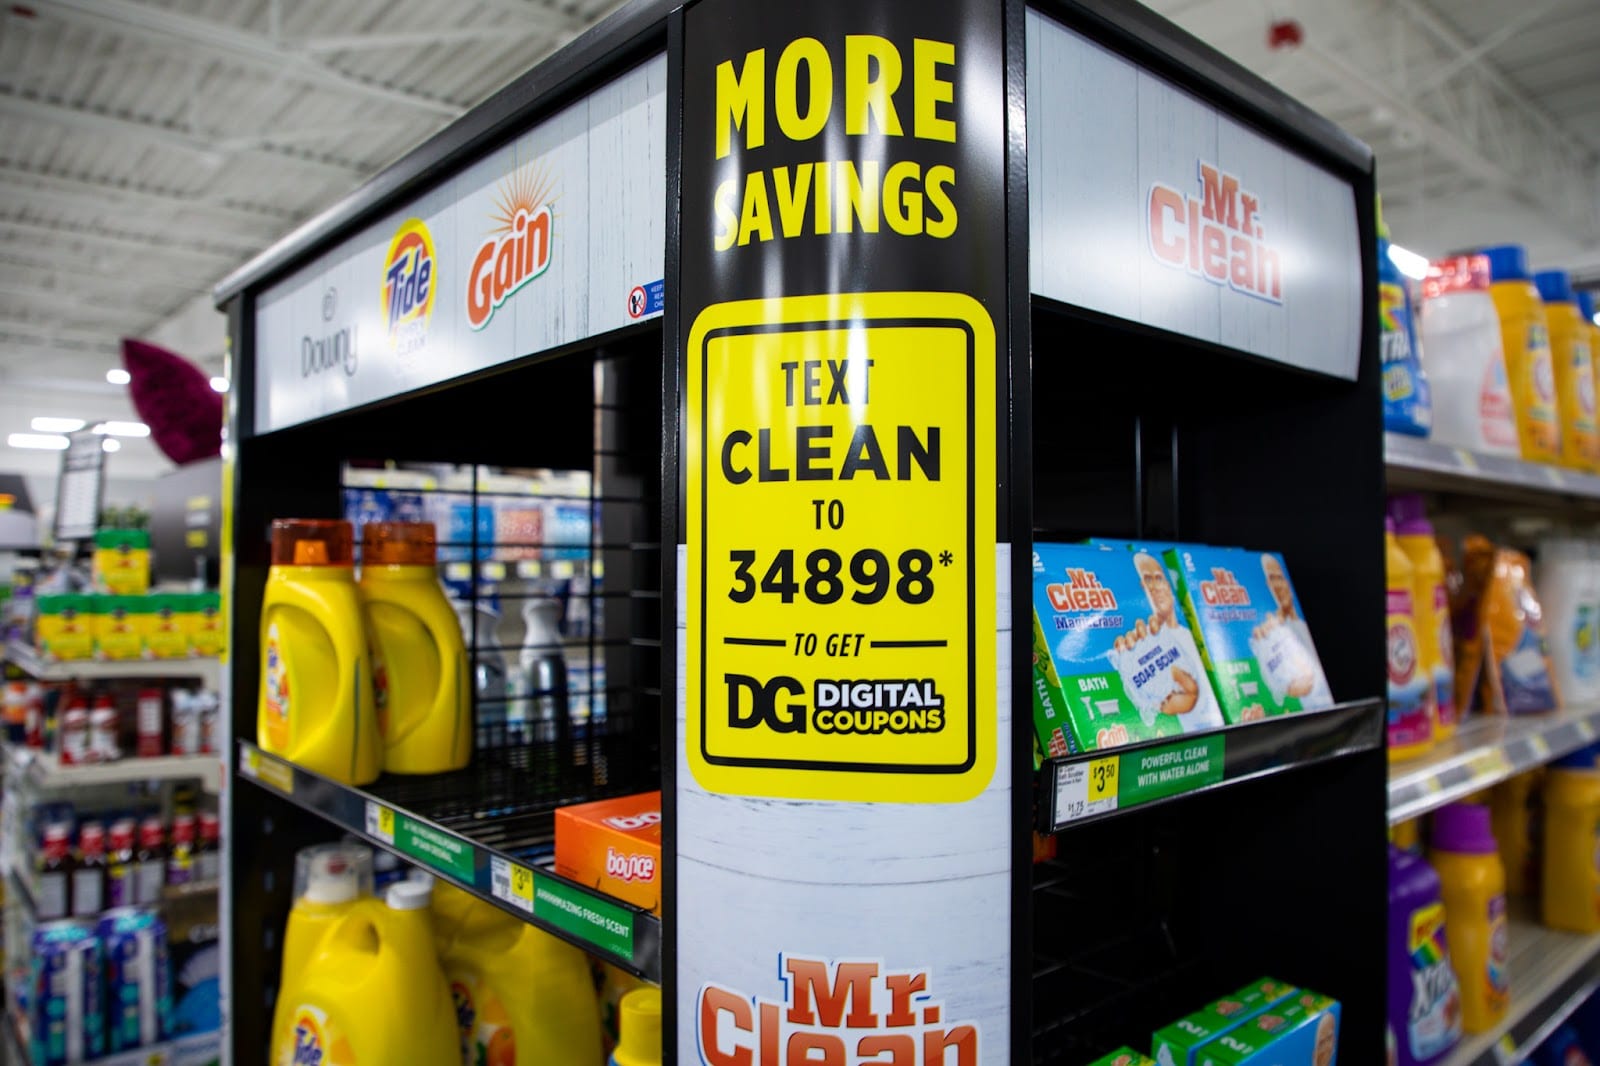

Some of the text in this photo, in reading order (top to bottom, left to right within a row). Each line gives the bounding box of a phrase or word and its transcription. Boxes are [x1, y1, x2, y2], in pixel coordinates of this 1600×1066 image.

[715, 34, 957, 161] MORE
[713, 159, 958, 252] SAVINGS
[1200, 163, 1263, 240] Mr.
[1149, 184, 1282, 300] Clean
[466, 211, 549, 326] Gain
[386, 248, 432, 336] Tide
[301, 323, 359, 377] Downy
[780, 358, 875, 407] TEXT
[720, 424, 941, 485] CLEAN
[812, 499, 845, 530] TO
[1047, 584, 1117, 611] Clean
[1066, 568, 1101, 588] Mr.
[1202, 581, 1251, 605] Clean
[794, 633, 865, 657] TO GET
[1078, 677, 1109, 692] BATH
[1132, 647, 1181, 689] SOAP SCUM
[723, 673, 808, 734] DG
[816, 681, 941, 708] DIGITAL
[1035, 678, 1055, 719] BATH
[815, 708, 942, 731] COUPONS
[1138, 759, 1210, 787] WITH WATER ALONE
[1141, 745, 1208, 770] POWERFUL CLEAN
[606, 847, 653, 881] bounce
[583, 907, 606, 926] FRESH
[605, 918, 630, 938] SCENT
[786, 957, 941, 1029] Mr.
